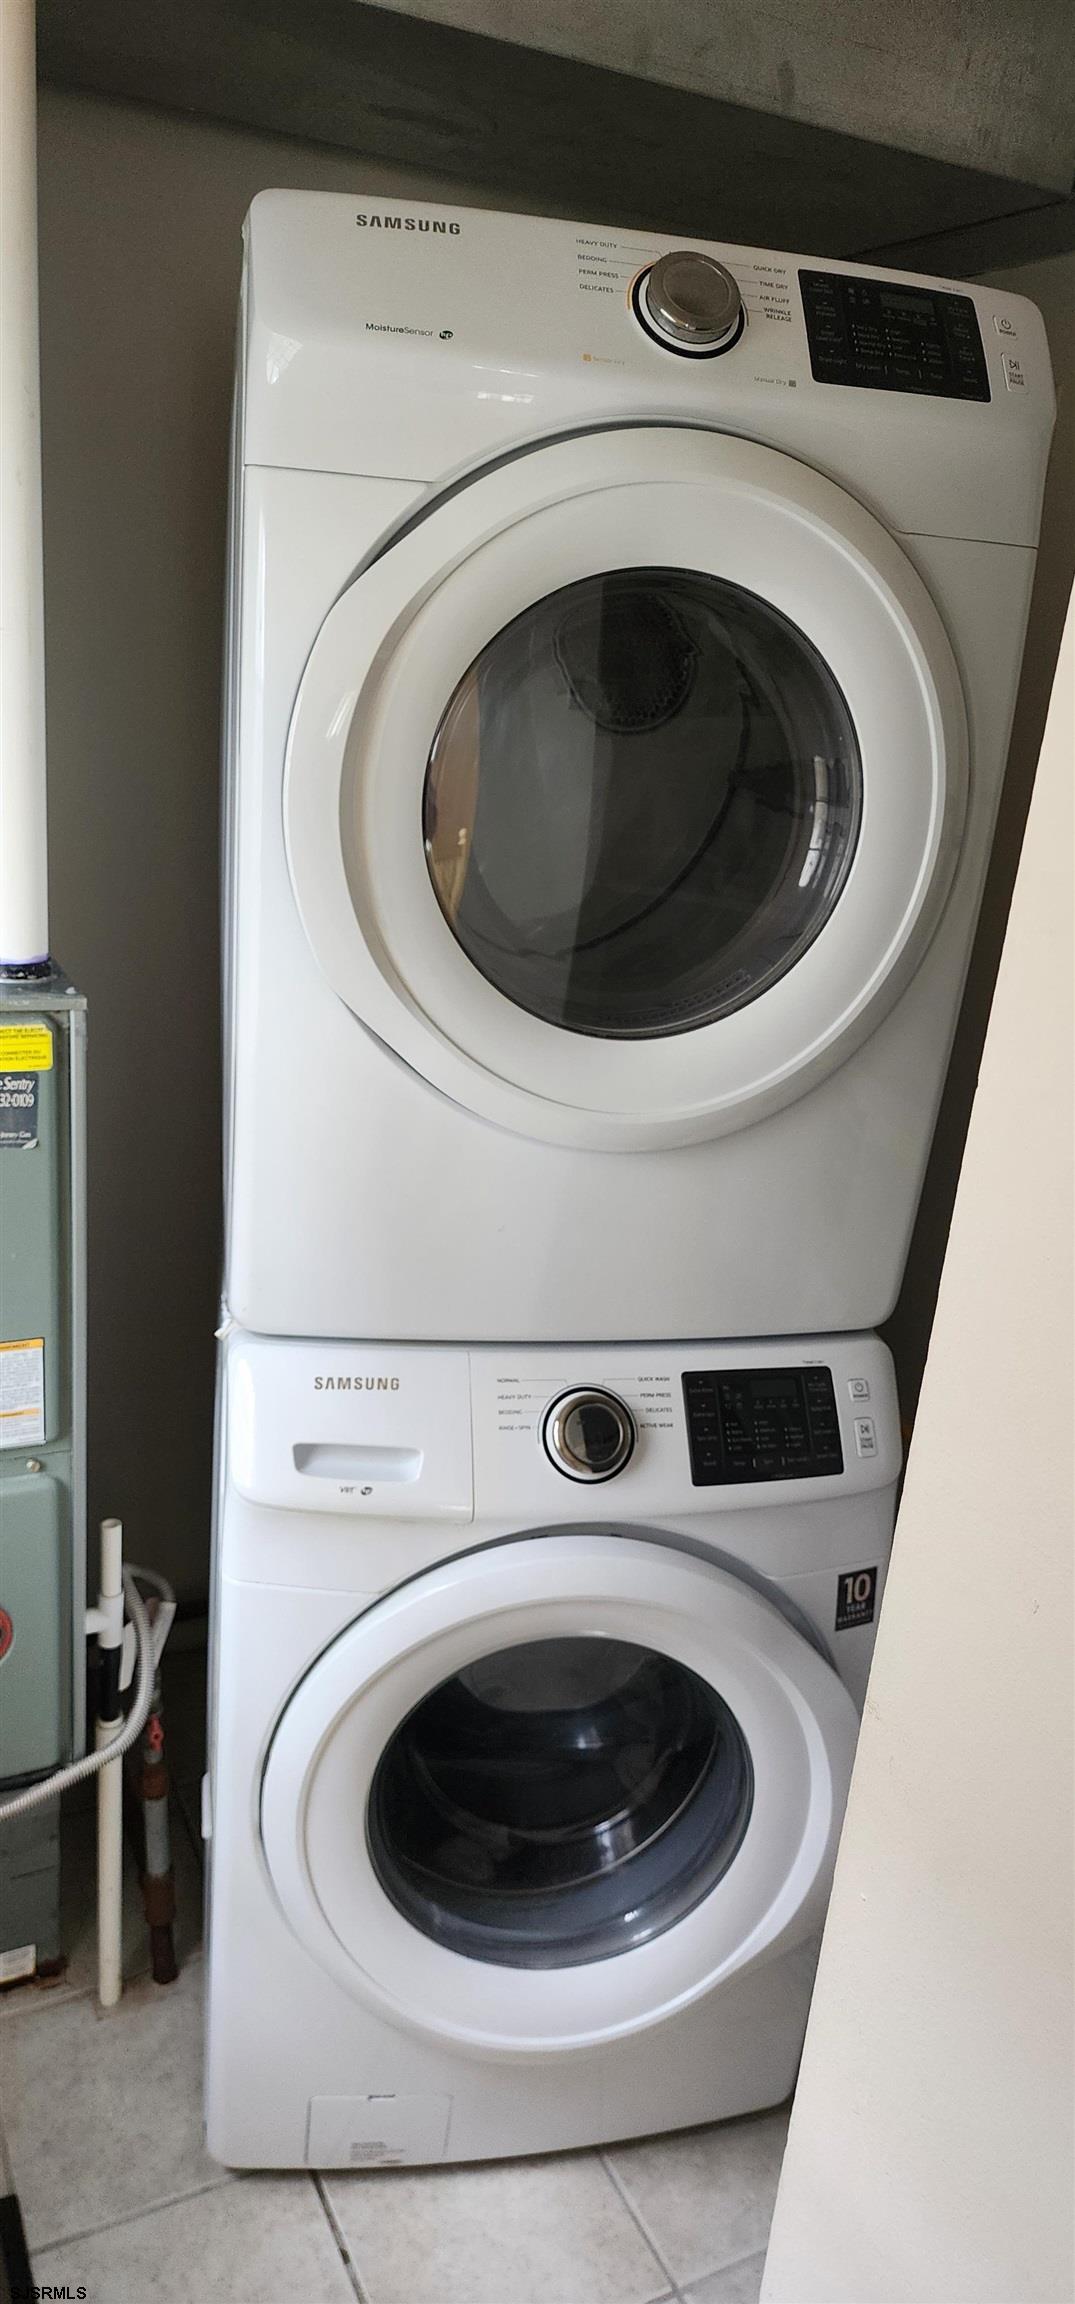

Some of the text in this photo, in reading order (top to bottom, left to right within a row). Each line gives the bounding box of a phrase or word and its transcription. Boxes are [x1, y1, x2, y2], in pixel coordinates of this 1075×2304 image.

[356, 214, 461, 235] SAMSUNG
[576, 239, 598, 247] HEAVY
[577, 254, 608, 263] BEDDING
[753, 265, 772, 273] QUICK
[578, 269, 619, 279] PERM PRESS
[579, 283, 614, 293] DELICATES
[760, 281, 788, 290] TIME DRY
[771, 296, 790, 304] FLUFF
[763, 307, 792, 316] WRINKLE
[766, 314, 792, 322] RELEASE
[365, 322, 434, 337] MoistureSensor
[3, 1076, 35, 1093] Sentry
[314, 1376, 400, 1391] SAMSUNG
[845, 1573, 871, 1604] 10
